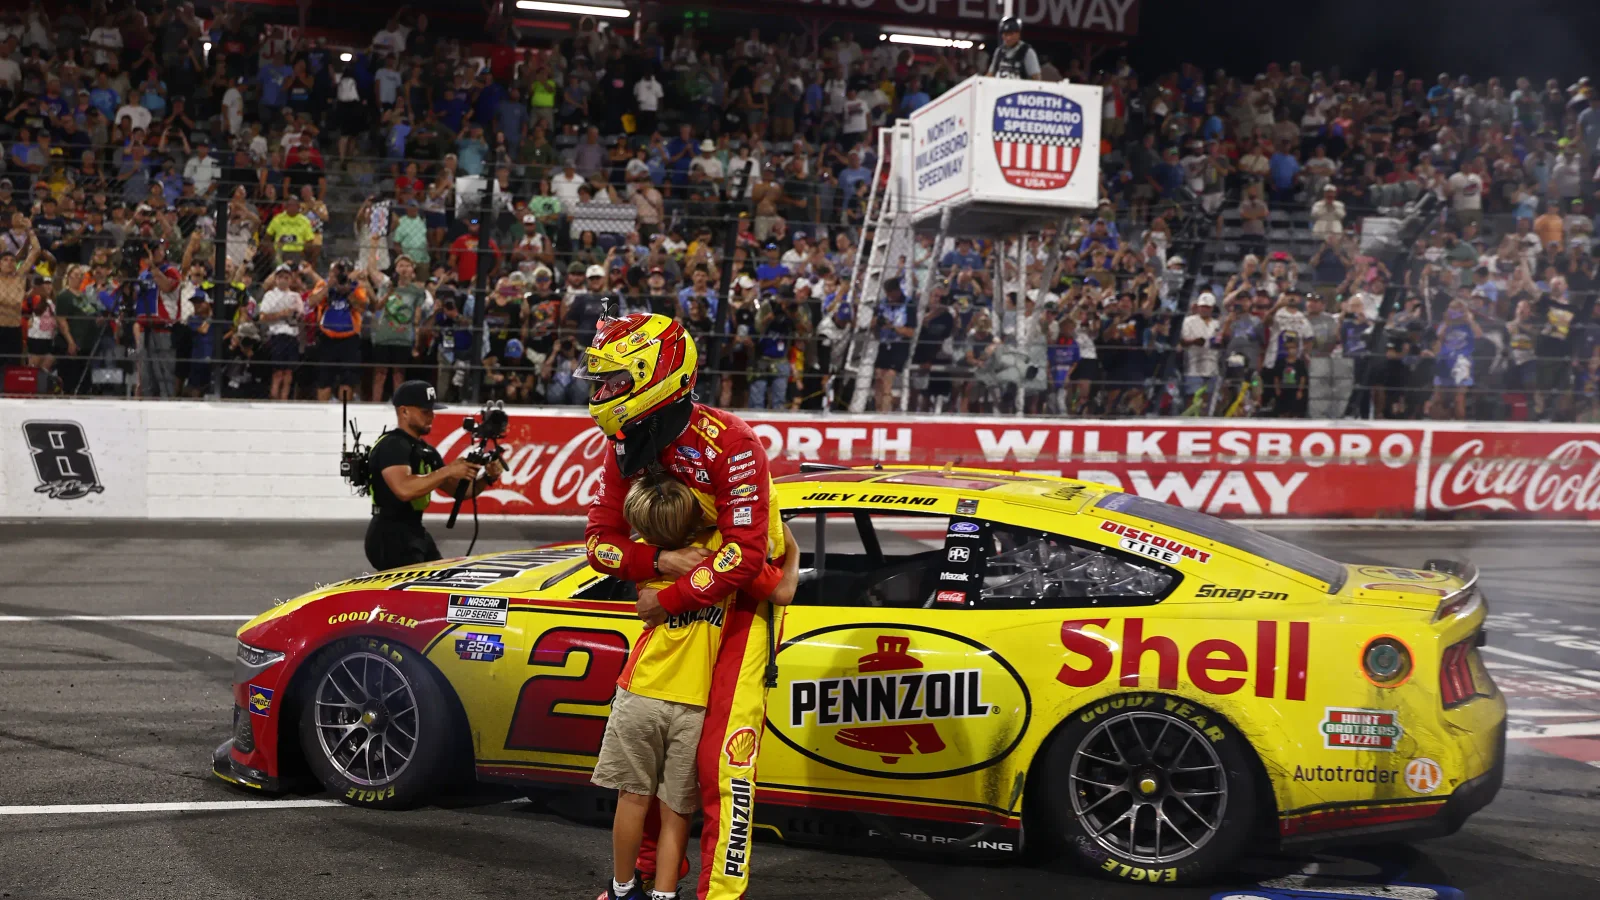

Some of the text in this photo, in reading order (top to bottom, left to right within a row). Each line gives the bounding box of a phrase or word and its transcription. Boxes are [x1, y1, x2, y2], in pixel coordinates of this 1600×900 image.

[1017, 94, 1062, 109] NORTH
[997, 106, 1081, 124] WILKESBORO
[926, 115, 956, 144] NORTH
[1003, 119, 1073, 136] SPEEDWAY
[915, 131, 968, 171] WILKESBORO
[918, 155, 965, 191] SPEEDWAY
[1024, 178, 1047, 188] USA
[22, 419, 102, 487] 8
[752, 423, 912, 461] ORTH
[975, 429, 1413, 468] WILKESBORO
[732, 485, 756, 495] SUNOCO
[802, 493, 939, 506] JOEY LOGANO
[1100, 521, 1211, 564] DISCOUNT
[950, 548, 968, 560] PPG
[1127, 541, 1175, 562] TIRE
[940, 572, 969, 581] Mazak
[1195, 584, 1289, 601] Snap-on
[467, 597, 500, 608] NASCAR
[455, 609, 499, 620] CUP SERIES
[466, 640, 494, 653] 250
[1056, 617, 1310, 702] Shell
[791, 670, 990, 727] PENNZOIL
[1340, 713, 1381, 725] HUNT
[1325, 723, 1396, 736] BROTHERS
[1339, 734, 1381, 745] PIZZA
[1293, 764, 1399, 784] Autotrader
[345, 784, 395, 802] EAGLE
[725, 777, 751, 877] PENNZOIL
[932, 837, 1013, 851] RAING
[1100, 858, 1178, 882] EAGLE
